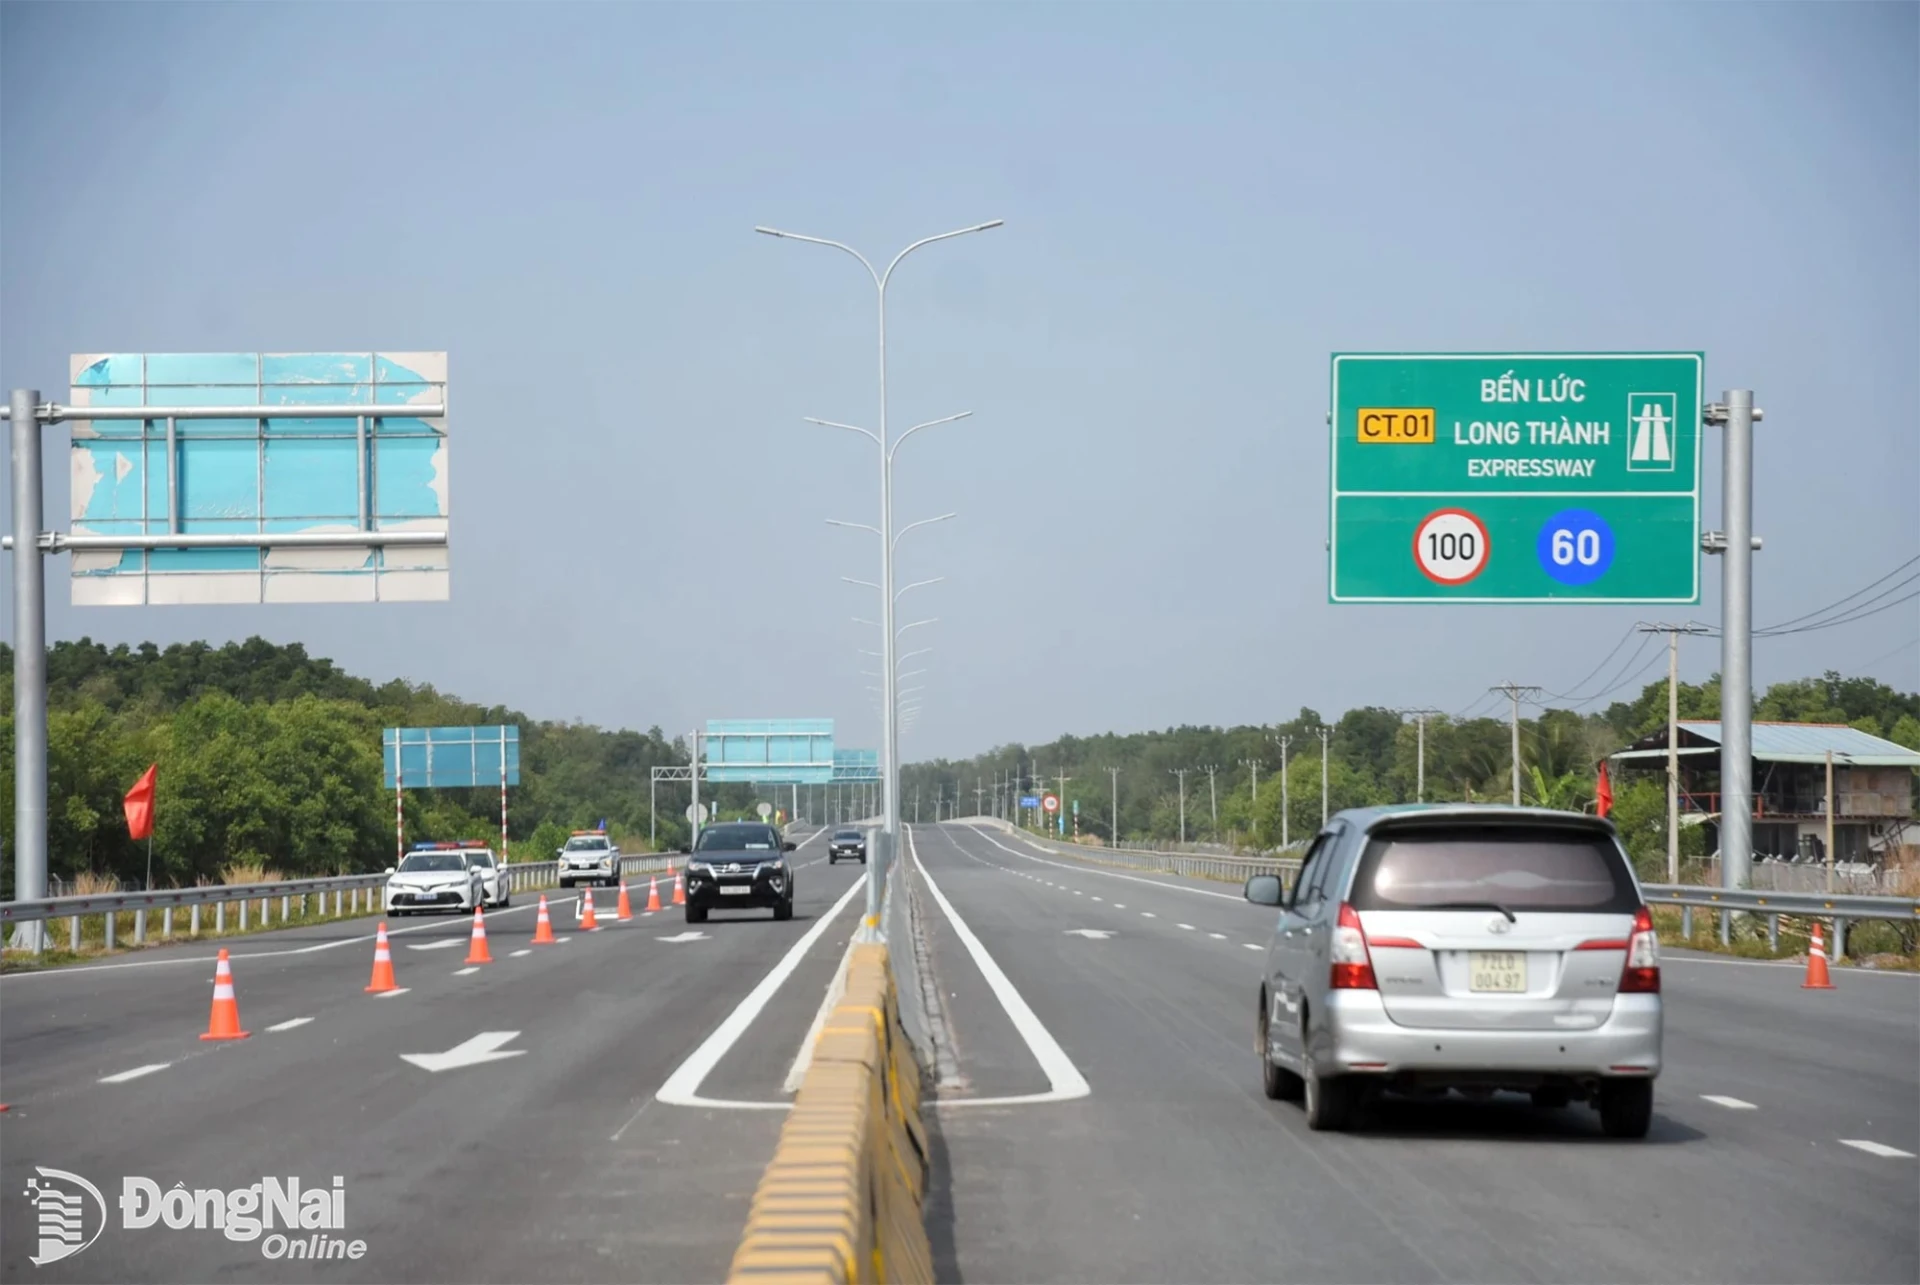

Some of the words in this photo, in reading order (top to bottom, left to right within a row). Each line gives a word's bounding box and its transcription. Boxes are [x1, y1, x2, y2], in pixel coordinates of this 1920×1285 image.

[1480, 370, 1529, 402] BẾN
[1537, 373, 1586, 402] LỨC
[1362, 414, 1430, 437] CT.01
[1454, 421, 1520, 445] LONG
[1526, 415, 1610, 445] THÀNH
[1468, 459, 1595, 477] EXPRESSWAY
[1428, 532, 1475, 560] 100
[1551, 530, 1600, 566] 60
